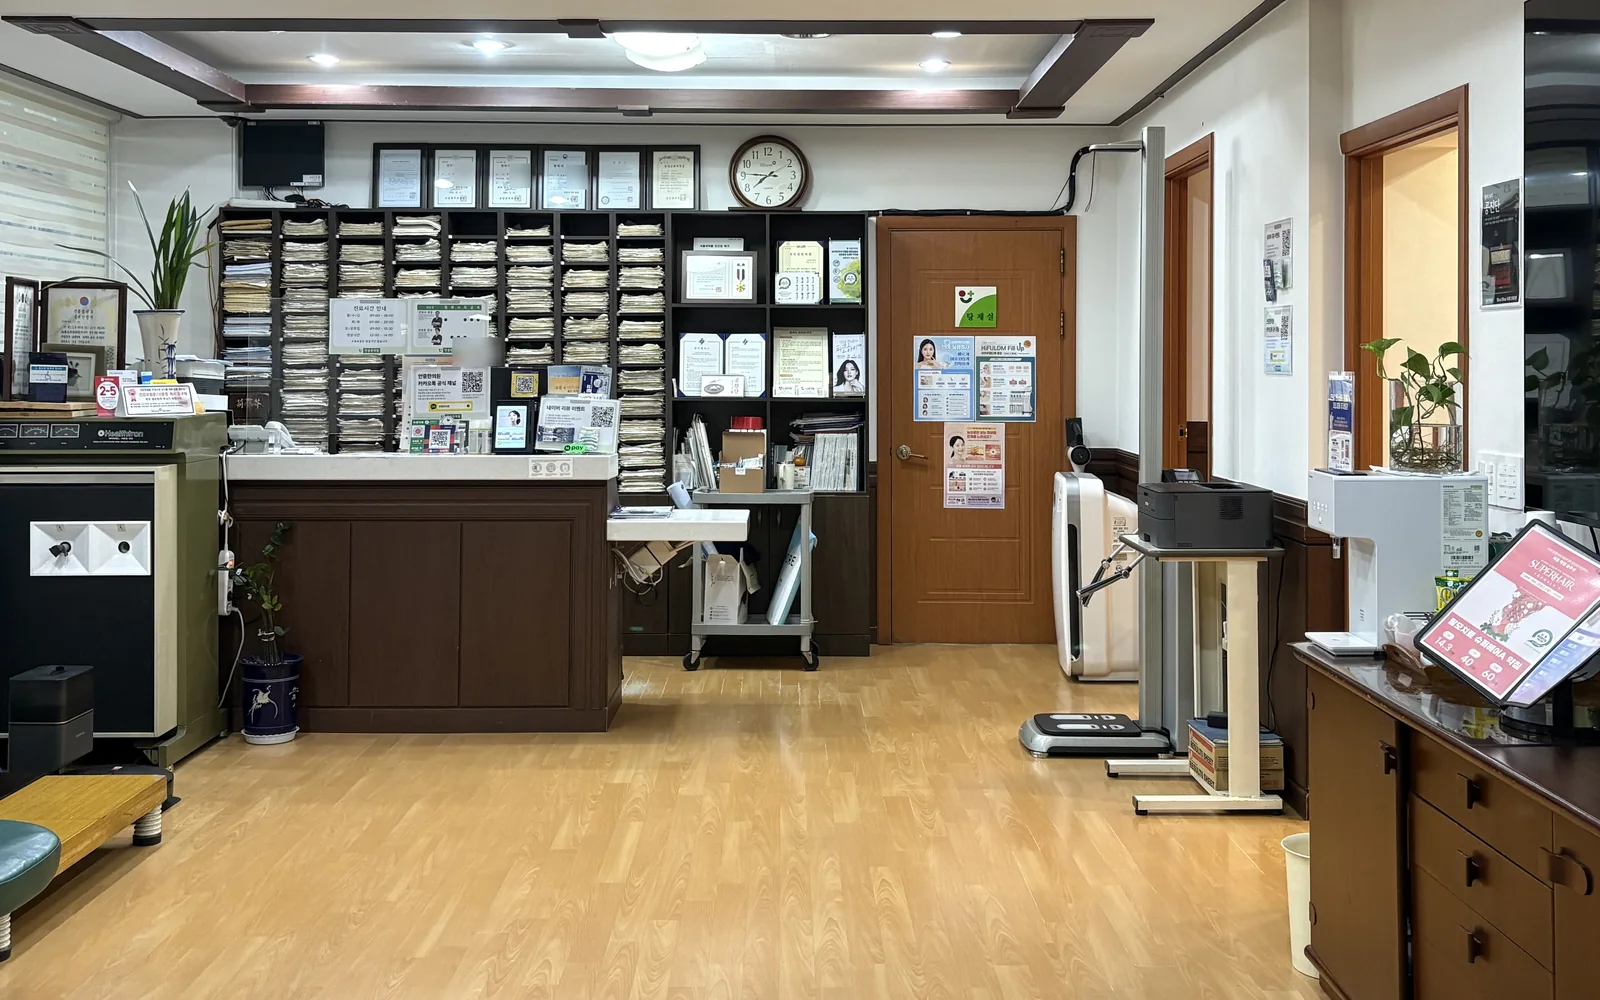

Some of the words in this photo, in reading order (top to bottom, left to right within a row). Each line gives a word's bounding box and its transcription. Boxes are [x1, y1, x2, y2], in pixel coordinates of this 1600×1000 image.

[752, 150, 758, 159] 11
[764, 147, 772, 156] 12
[779, 150, 782, 159] 1
[743, 160, 751, 168] 10
[787, 159, 792, 167] 2
[741, 172, 746, 180] 9
[791, 171, 796, 180] 3
[745, 183, 750, 192] 8
[788, 183, 793, 191] 4
[754, 193, 760, 201] 7
[766, 196, 771, 204] 6
[779, 192, 784, 201] 5
[1484, 198, 1500, 215] 공진단
[1017, 342, 1024, 352] Up
[1528, 559, 1576, 591] SUPERHAIR
[1447, 618, 1476, 638] 탈모치료
[1474, 635, 1506, 659] 슈퍼헤어A
[1505, 656, 1523, 670] 약침
